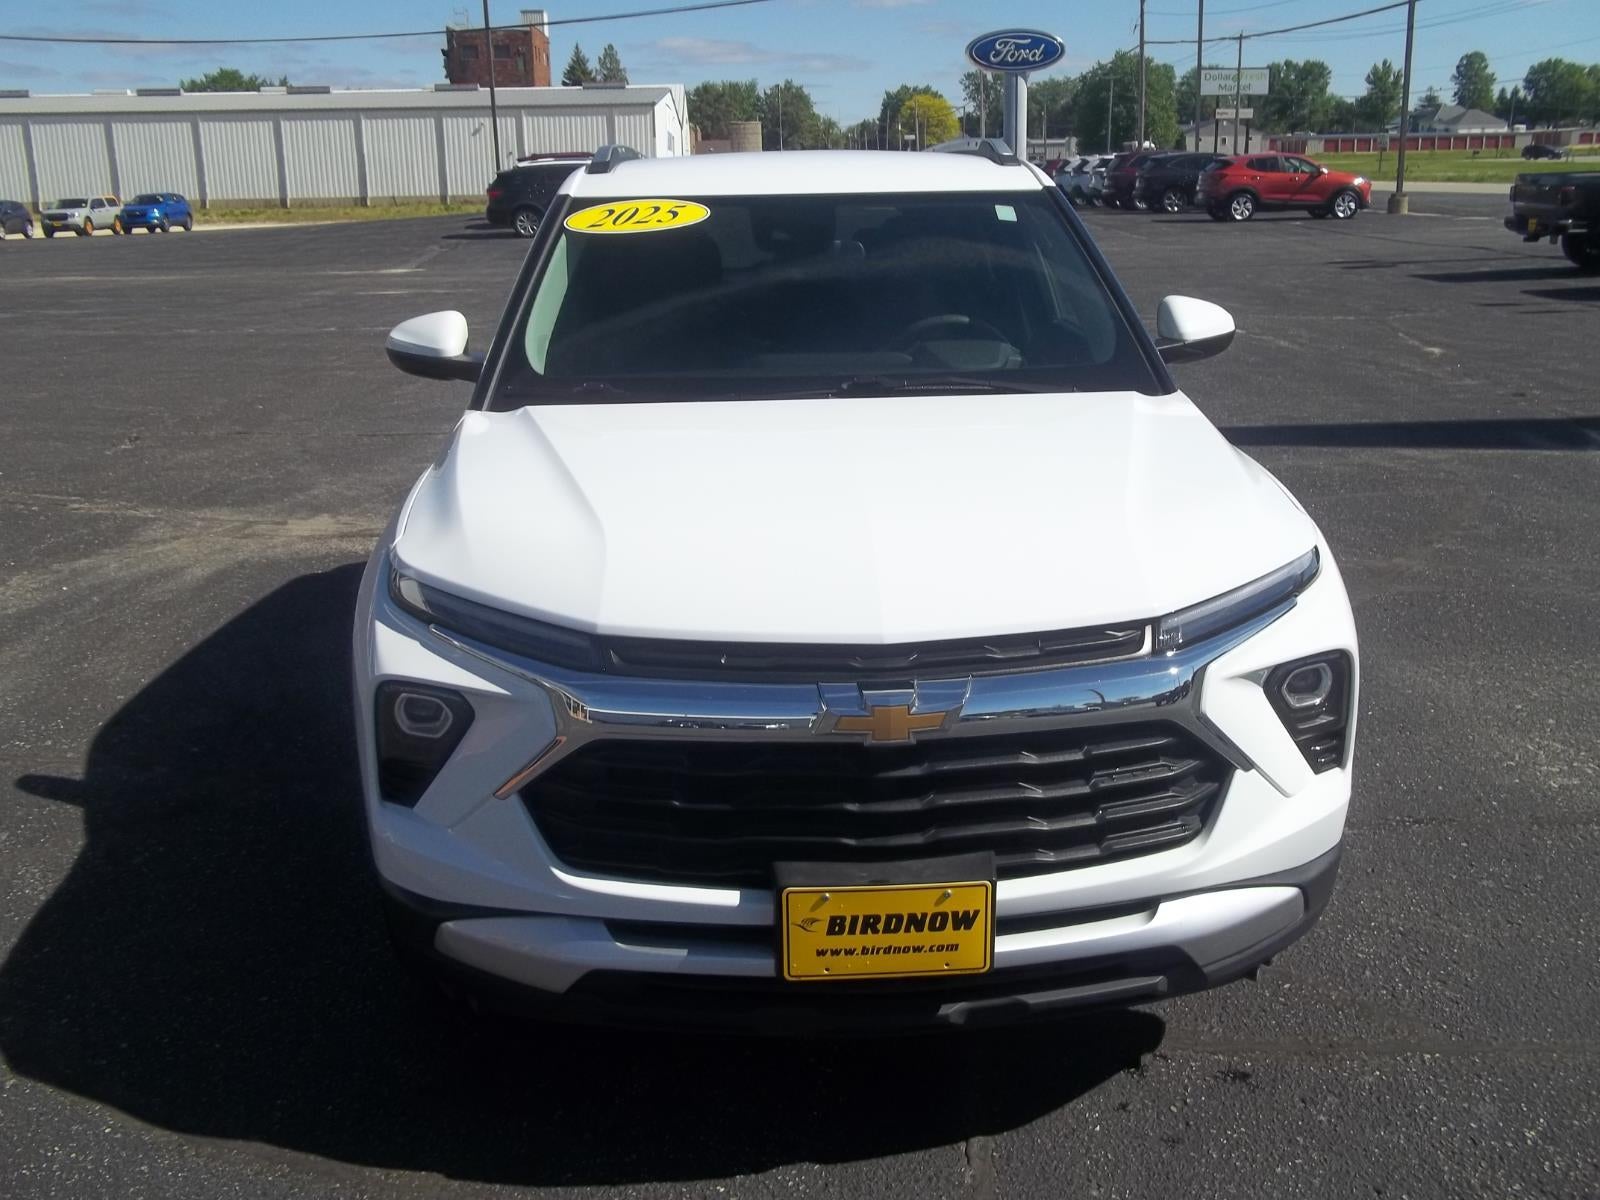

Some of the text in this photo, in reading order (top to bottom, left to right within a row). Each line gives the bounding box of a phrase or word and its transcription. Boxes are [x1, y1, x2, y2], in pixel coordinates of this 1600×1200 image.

[990, 38, 1045, 62] Ford
[1204, 72, 1231, 81] Dollar
[587, 205, 687, 229] 2025
[826, 909, 980, 936] BIRDNOW
[816, 944, 959, 957] www.birdnow.com
